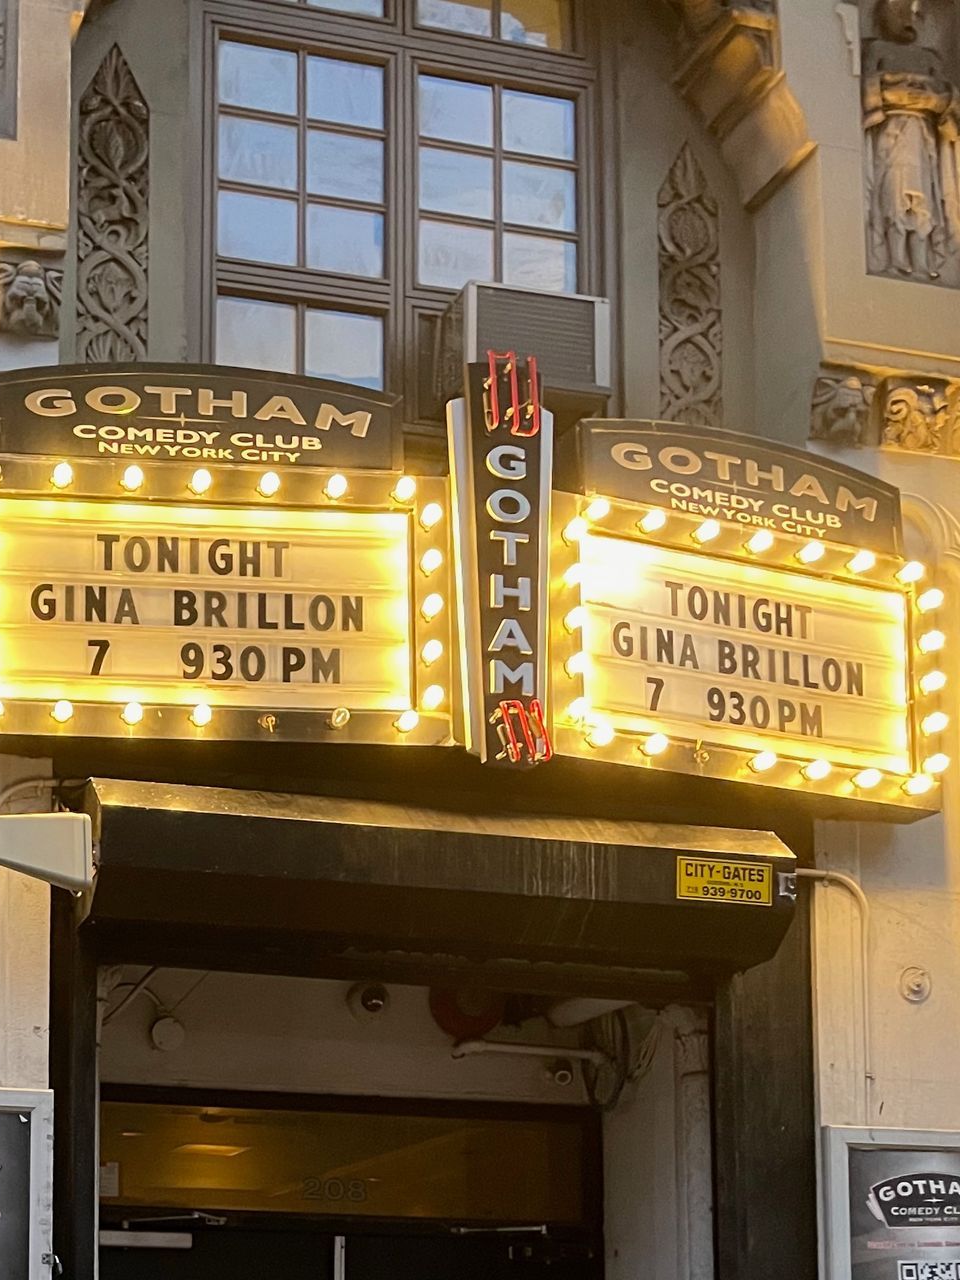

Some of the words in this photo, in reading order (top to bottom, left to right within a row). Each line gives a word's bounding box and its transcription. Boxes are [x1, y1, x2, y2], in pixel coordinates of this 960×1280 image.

[24, 385, 373, 438] GOTHAM
[72, 424, 221, 445] COMEDY
[230, 433, 322, 450] CLUB
[241, 449, 301, 463] CITY
[610, 442, 878, 522] GOTHAM
[649, 479, 764, 512] COMEDY
[771, 504, 842, 529] CLUB
[781, 521, 827, 538] CITY
[97, 534, 290, 578] TONIGHT
[486, 444, 534, 697] GOTHAM
[30, 583, 139, 625] GINA
[173, 590, 364, 632] BRILLON
[665, 581, 813, 639] TONIGHT
[88, 640, 111, 676] 7
[612, 622, 700, 670] GINA
[718, 639, 864, 697] BRILLON
[646, 677, 665, 711] 7
[685, 863, 764, 882] CITY-GATES
[303, 1178, 366, 1201] 208
[891, 1207, 940, 1215] COMEDY
